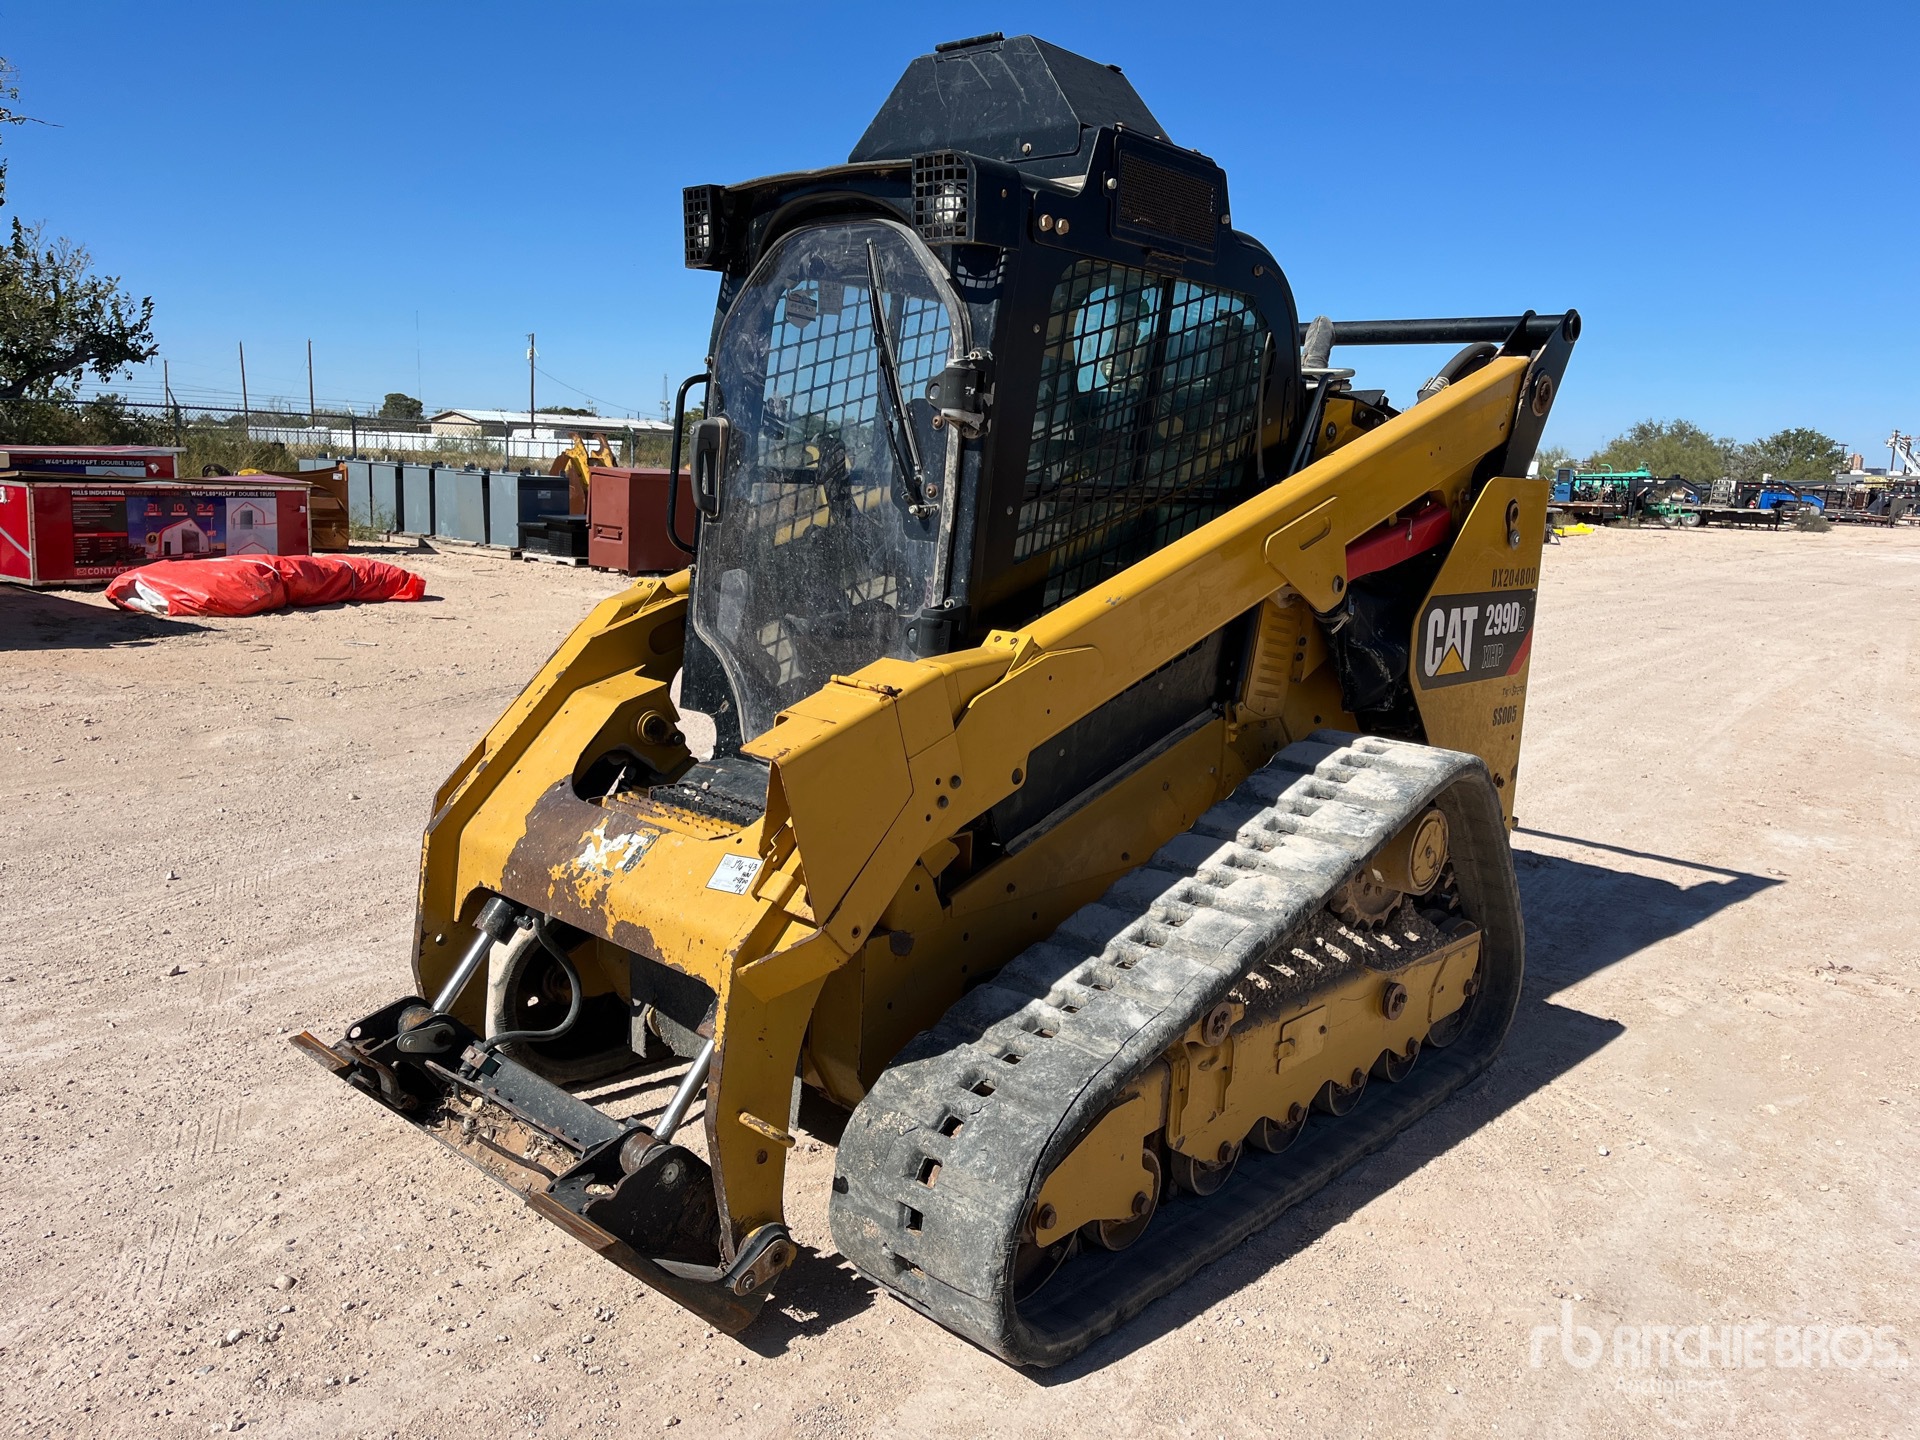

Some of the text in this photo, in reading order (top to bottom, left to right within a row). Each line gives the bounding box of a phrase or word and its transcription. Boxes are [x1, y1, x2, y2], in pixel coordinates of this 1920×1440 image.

[88, 567, 128, 575] CONTACT
[1491, 567, 1537, 588] DX204800
[1424, 605, 1479, 677] CAT
[1482, 643, 1504, 669] XHP
[1492, 704, 1518, 726] SS005
